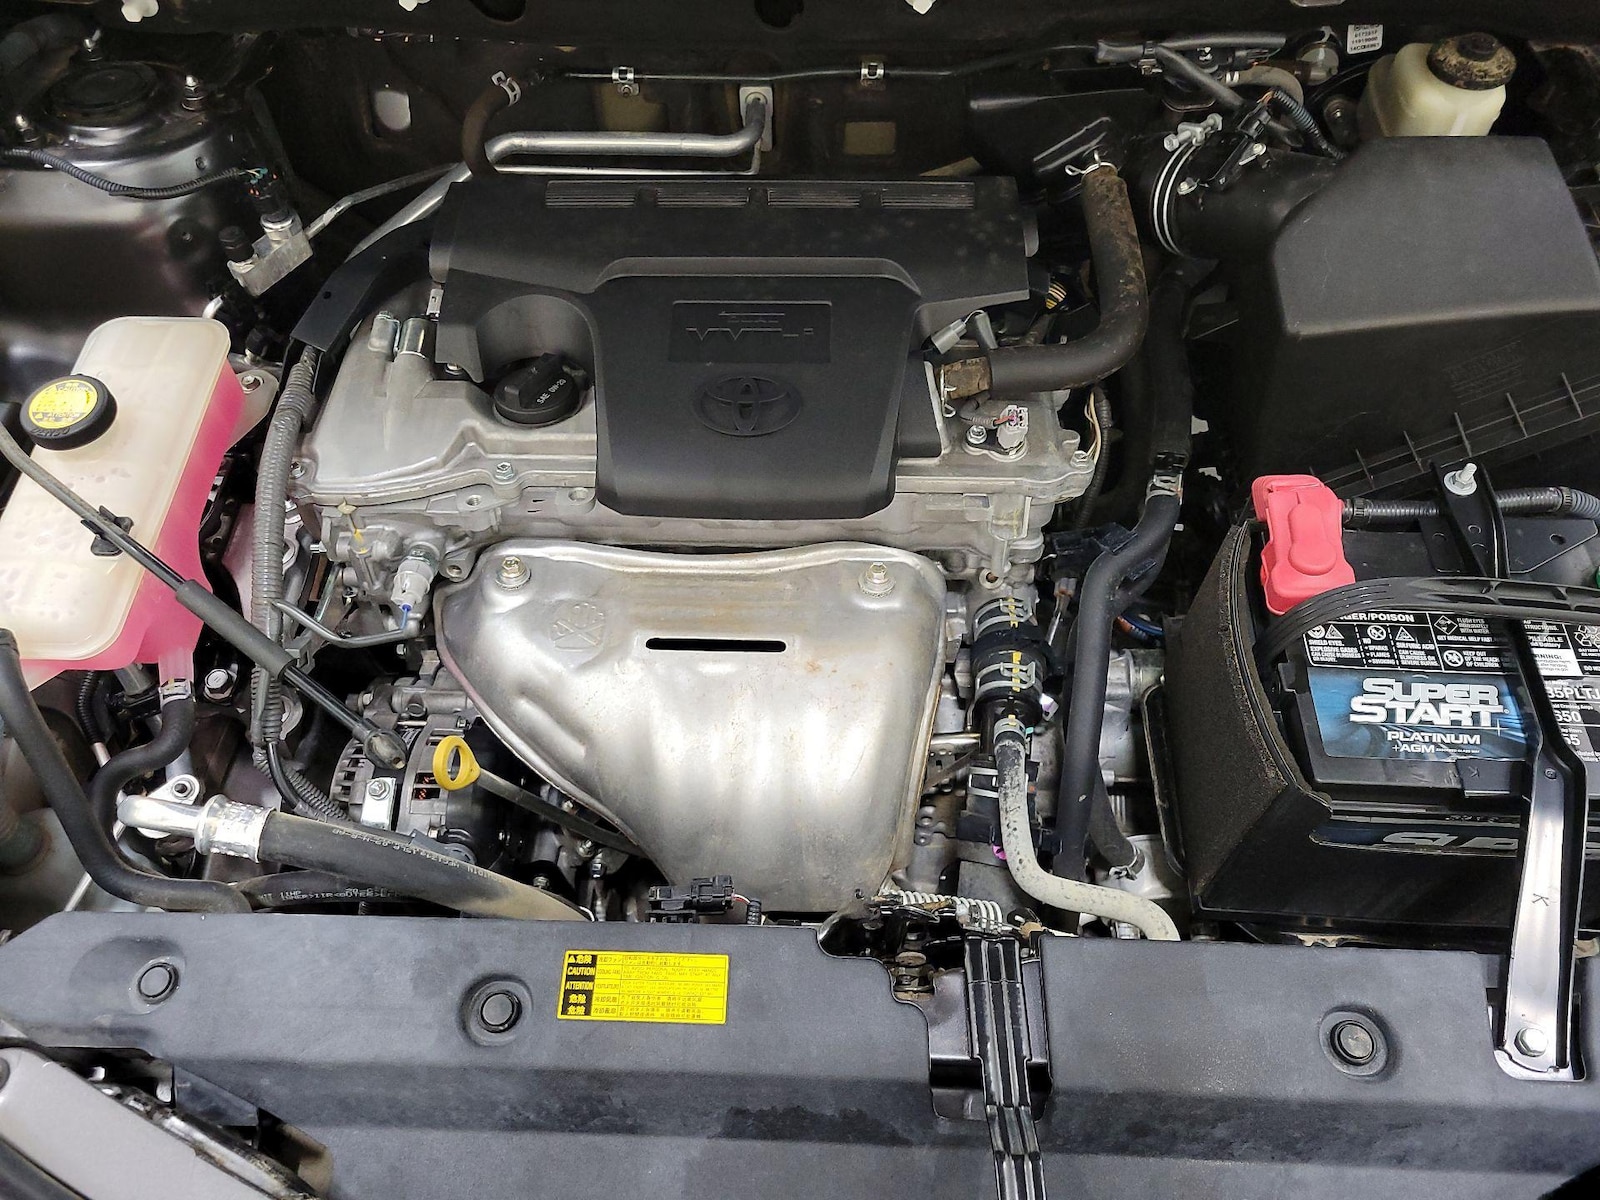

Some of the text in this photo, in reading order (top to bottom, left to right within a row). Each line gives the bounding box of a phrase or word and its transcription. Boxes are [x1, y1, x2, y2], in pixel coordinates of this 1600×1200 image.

[536, 392, 551, 404] SAE
[1338, 612, 1415, 622] GER/POISON
[1363, 677, 1499, 706] SUPER
[1350, 696, 1503, 727] START
[1387, 731, 1481, 745] PLATINUM
[567, 966, 596, 976] CAUTION
[565, 981, 594, 990] ATTENTION
